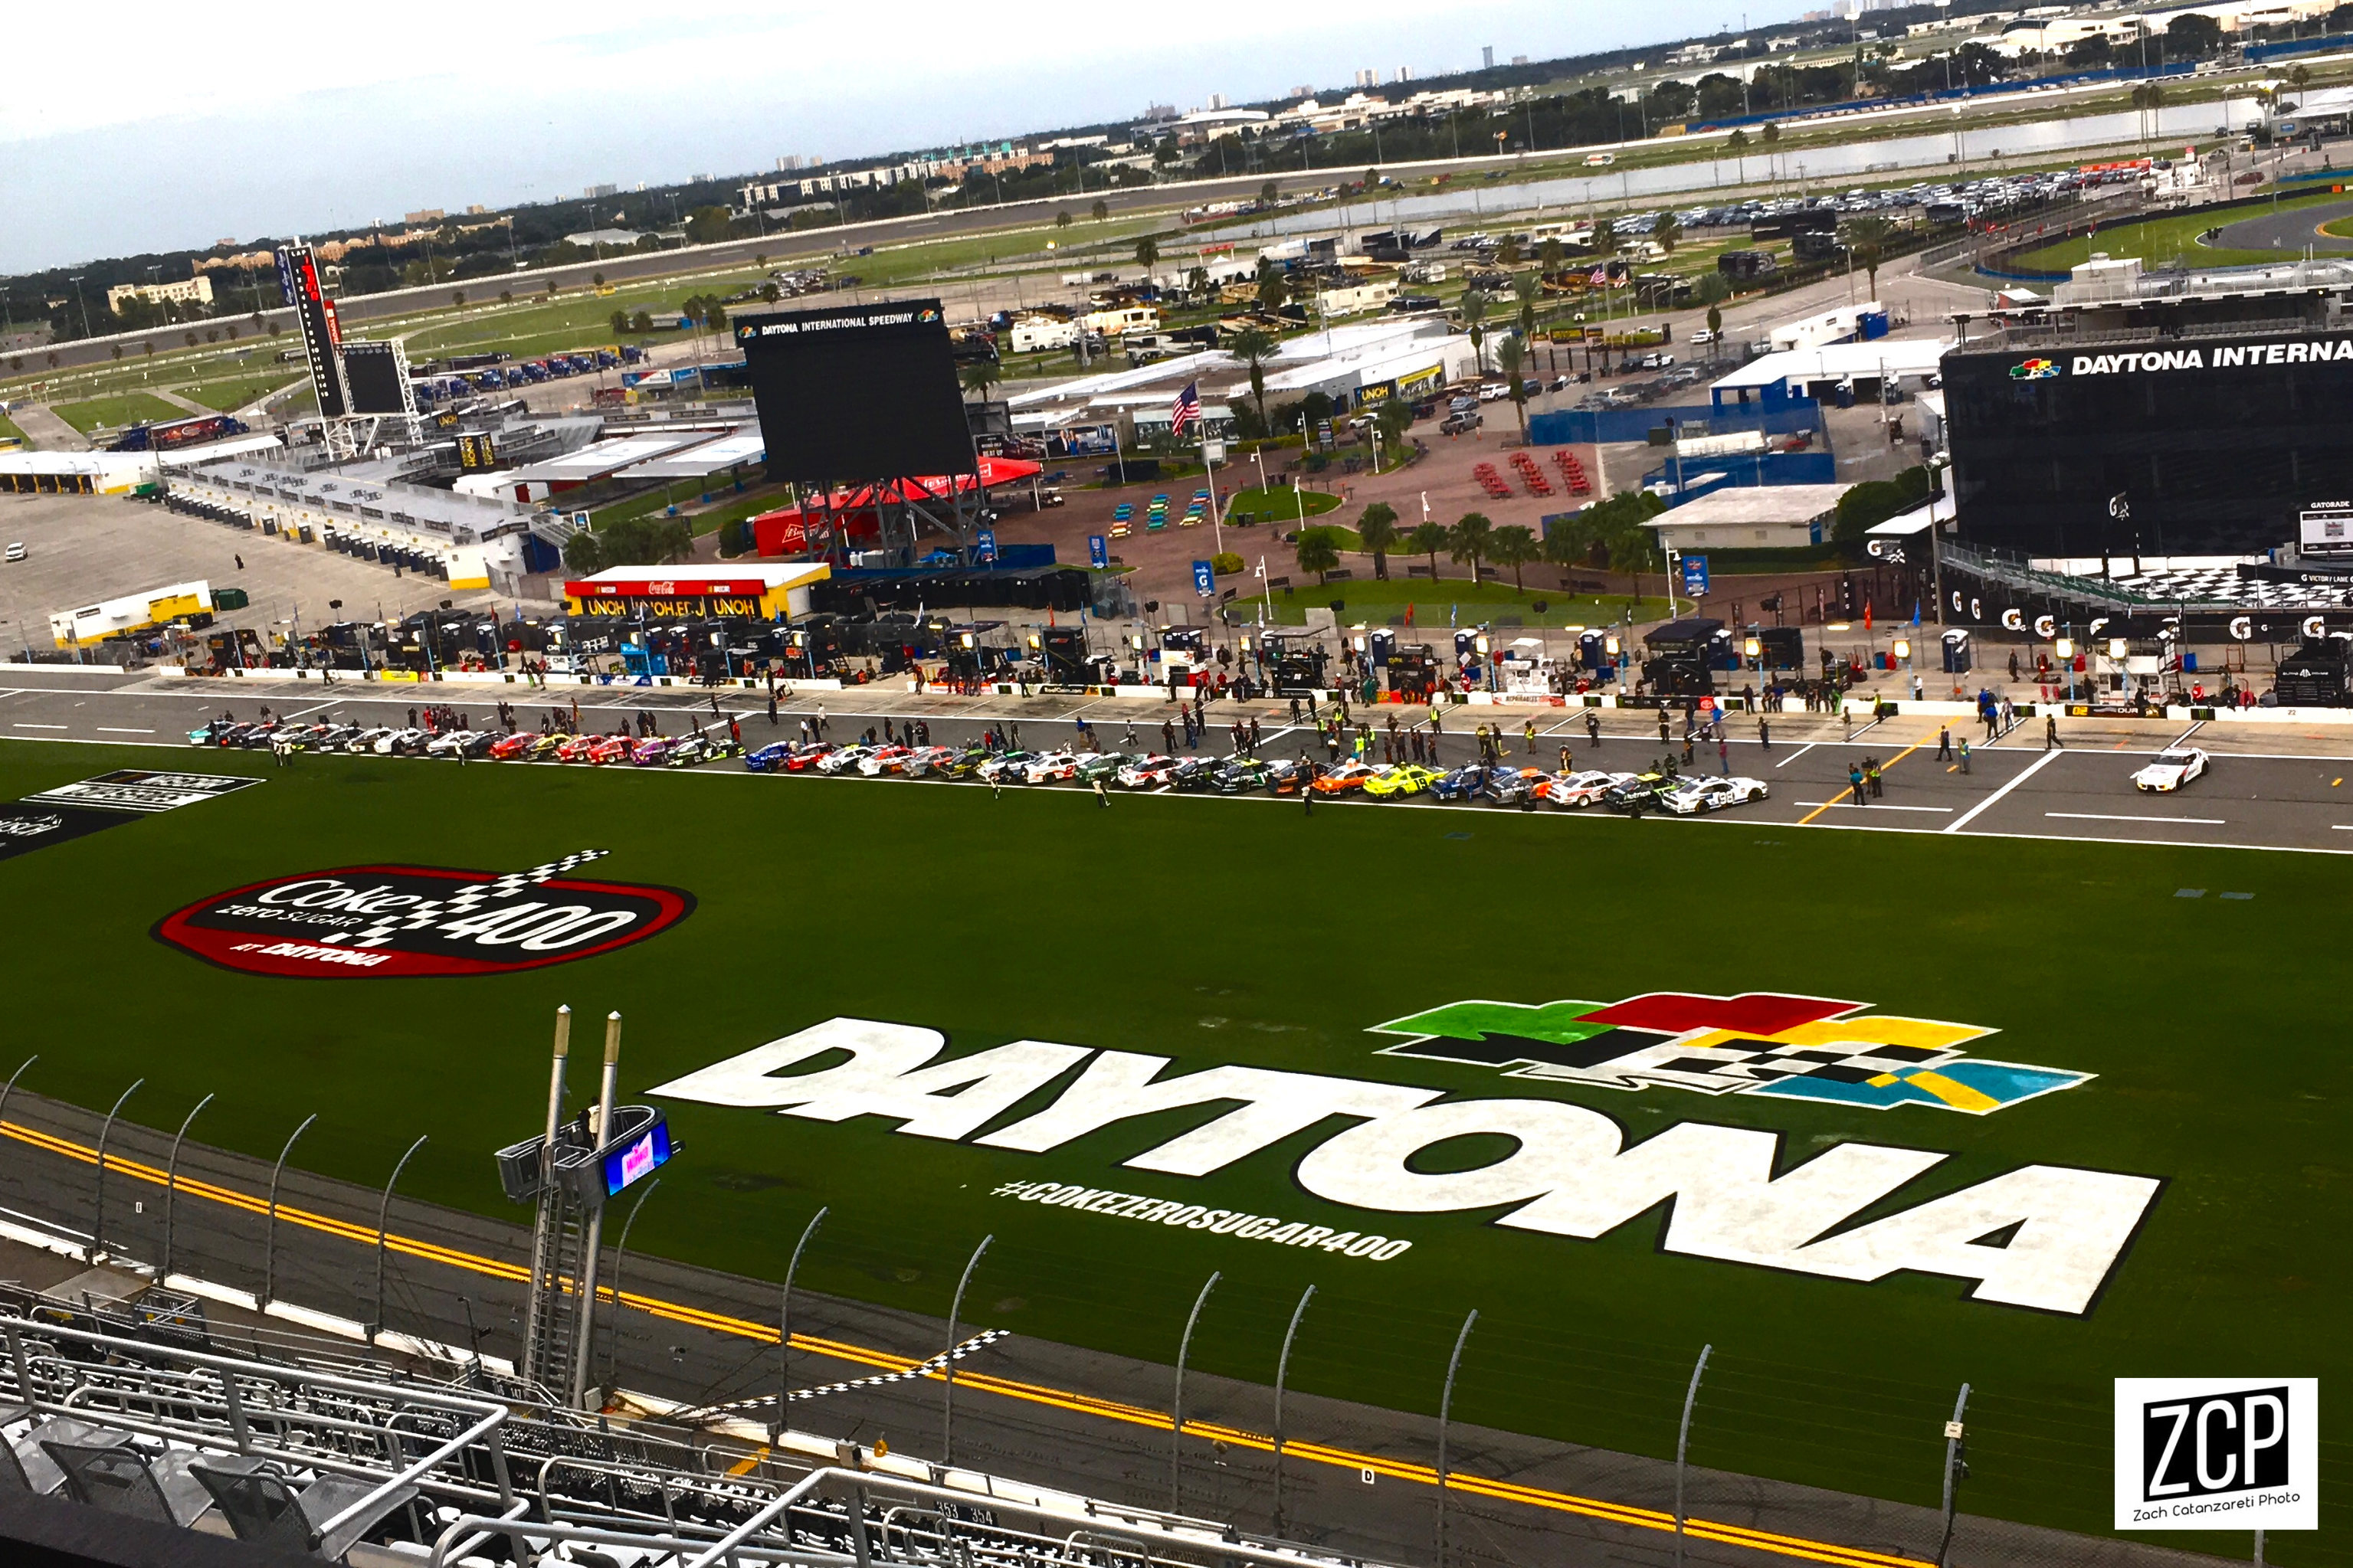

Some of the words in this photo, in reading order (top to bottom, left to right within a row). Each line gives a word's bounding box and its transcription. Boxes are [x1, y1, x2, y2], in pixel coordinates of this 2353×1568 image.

[762, 322, 798, 335] DAYTONA
[801, 316, 867, 332] INTERNATIONAL
[869, 313, 913, 326] SPEEDWAY
[2072, 349, 2204, 375] DAYTONA
[2212, 339, 2353, 367] INTERNA
[1362, 386, 1388, 401] UNOH
[438, 414, 457, 427] UNOH
[1867, 539, 1882, 556] G
[588, 598, 627, 616] UNOH
[713, 597, 755, 616] UNOH
[1952, 591, 1961, 612] G
[1971, 598, 1981, 620] G
[2001, 608, 2021, 630] G
[2034, 615, 2054, 637] G
[2230, 617, 2252, 640] G
[2302, 616, 2325, 638] G
[1414, 777, 1428, 791] 19
[1718, 791, 1735, 804] 98
[258, 880, 423, 914] Coke
[215, 905, 285, 918] zero
[277, 912, 364, 928] SUGAR
[436, 902, 637, 951] 400
[257, 943, 391, 967] DAYTONA
[644, 1017, 2160, 1314] DAYTONA
[989, 1180, 1413, 1261] #COKEZEROSUGAR400
[1365, 1470, 1372, 1481] D
[970, 1507, 993, 1525] 354
